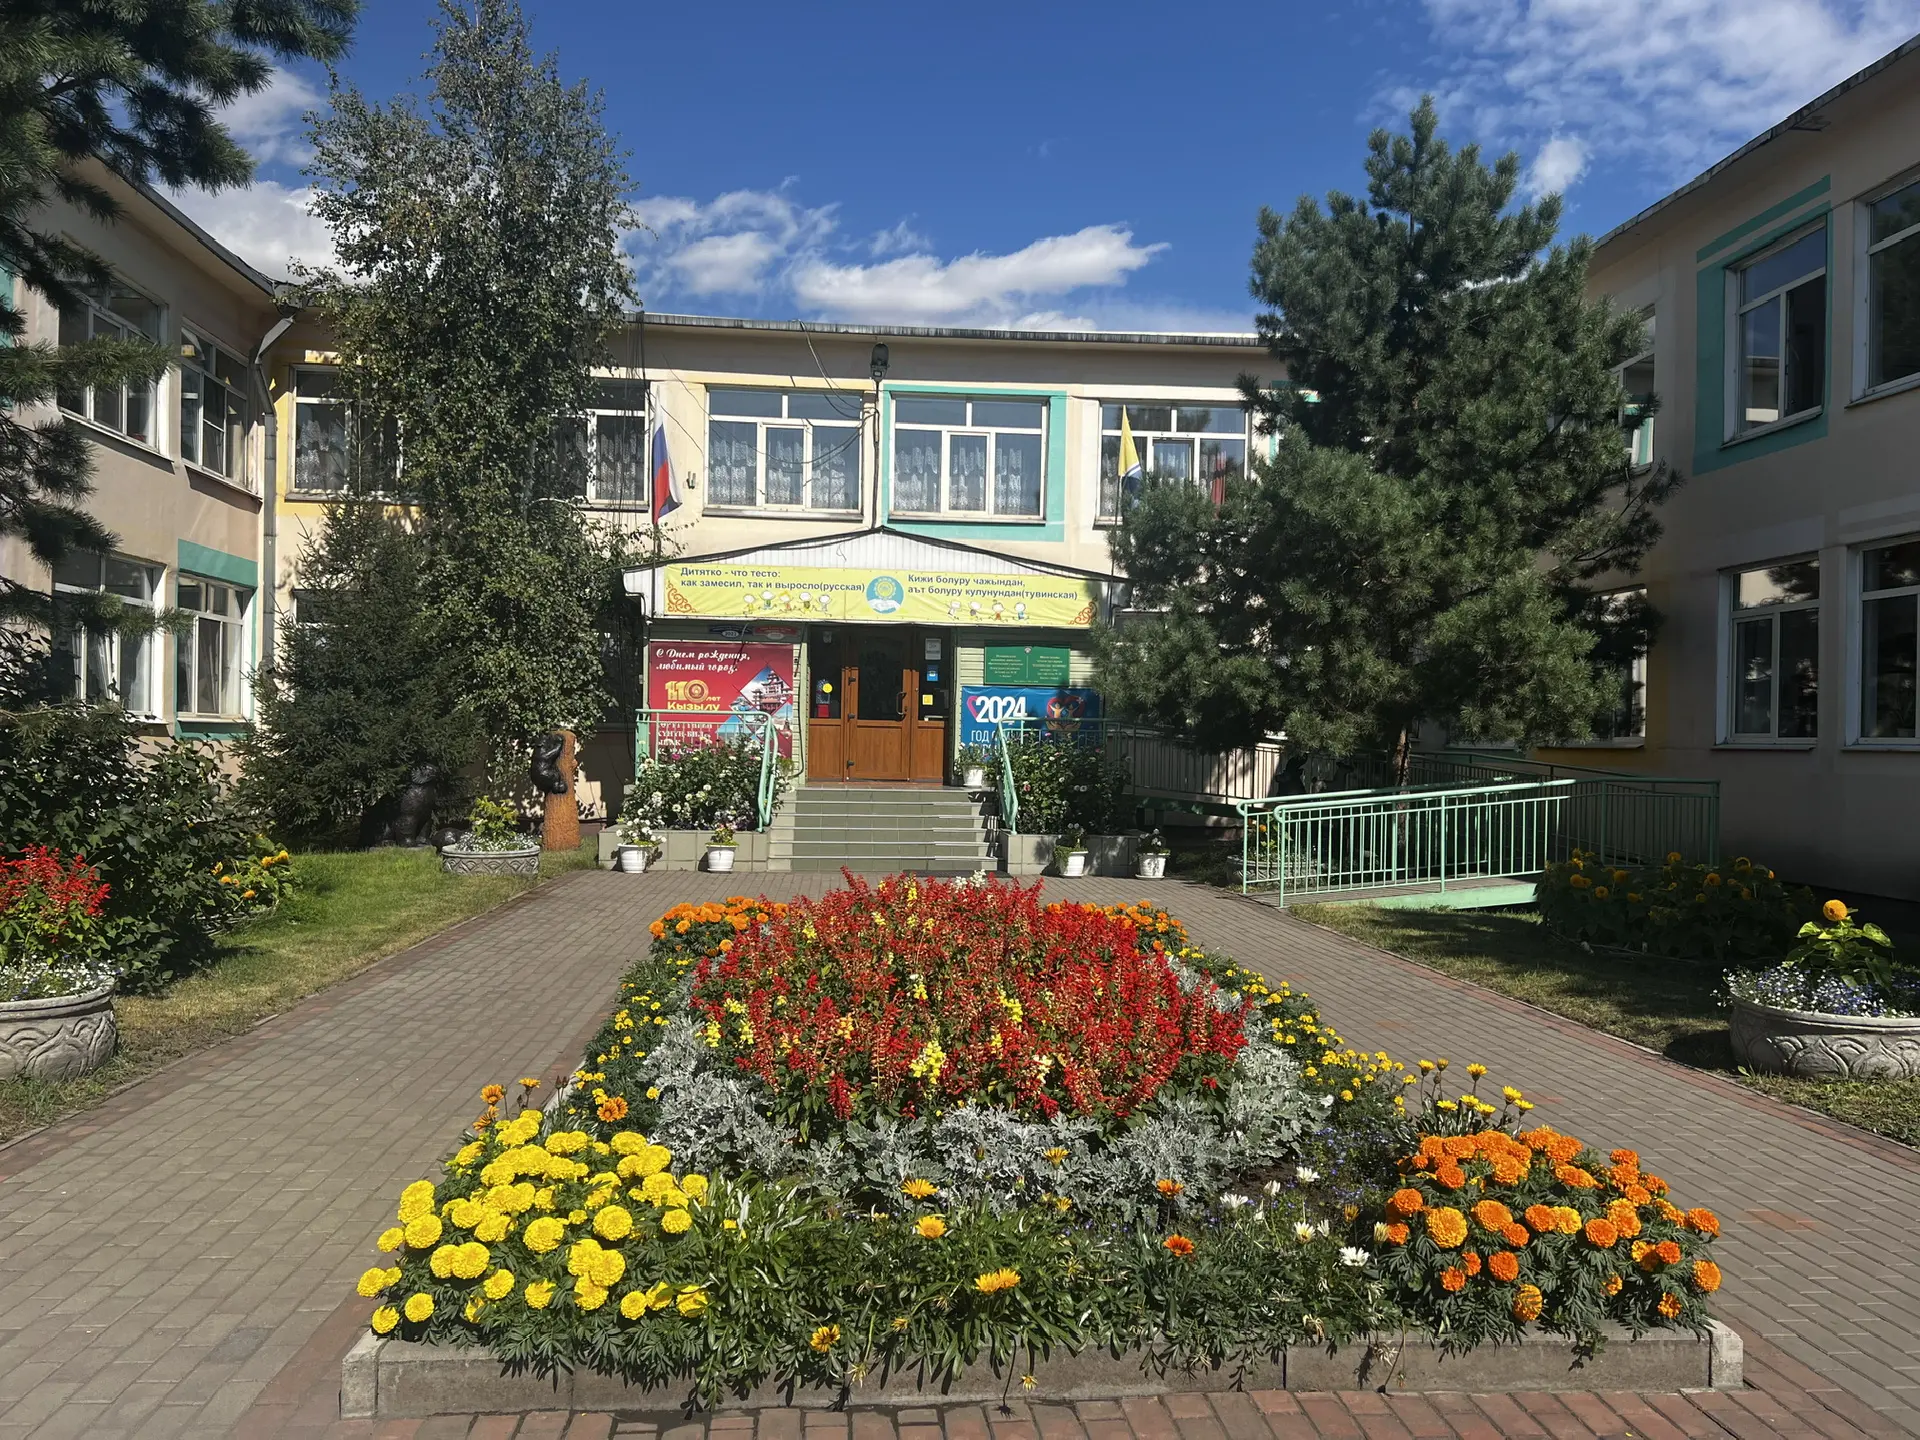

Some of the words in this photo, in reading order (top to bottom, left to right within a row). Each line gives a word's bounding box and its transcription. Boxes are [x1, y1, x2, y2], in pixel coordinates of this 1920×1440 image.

[680, 567, 722, 577] Дитятко
[731, 570, 748, 578] что
[750, 570, 781, 578] тесто:
[699, 580, 745, 589] замесил,
[747, 581, 764, 589] так
[908, 574, 933, 584] Кижи
[935, 575, 970, 587] болуру
[973, 578, 1026, 587] чажындан,
[927, 585, 962, 597] болуру
[656, 649, 664, 658] С
[656, 660, 705, 671] любимый
[667, 701, 721, 711] Кызылу
[976, 695, 1028, 723] 2024
[971, 730, 990, 743] ГОД
